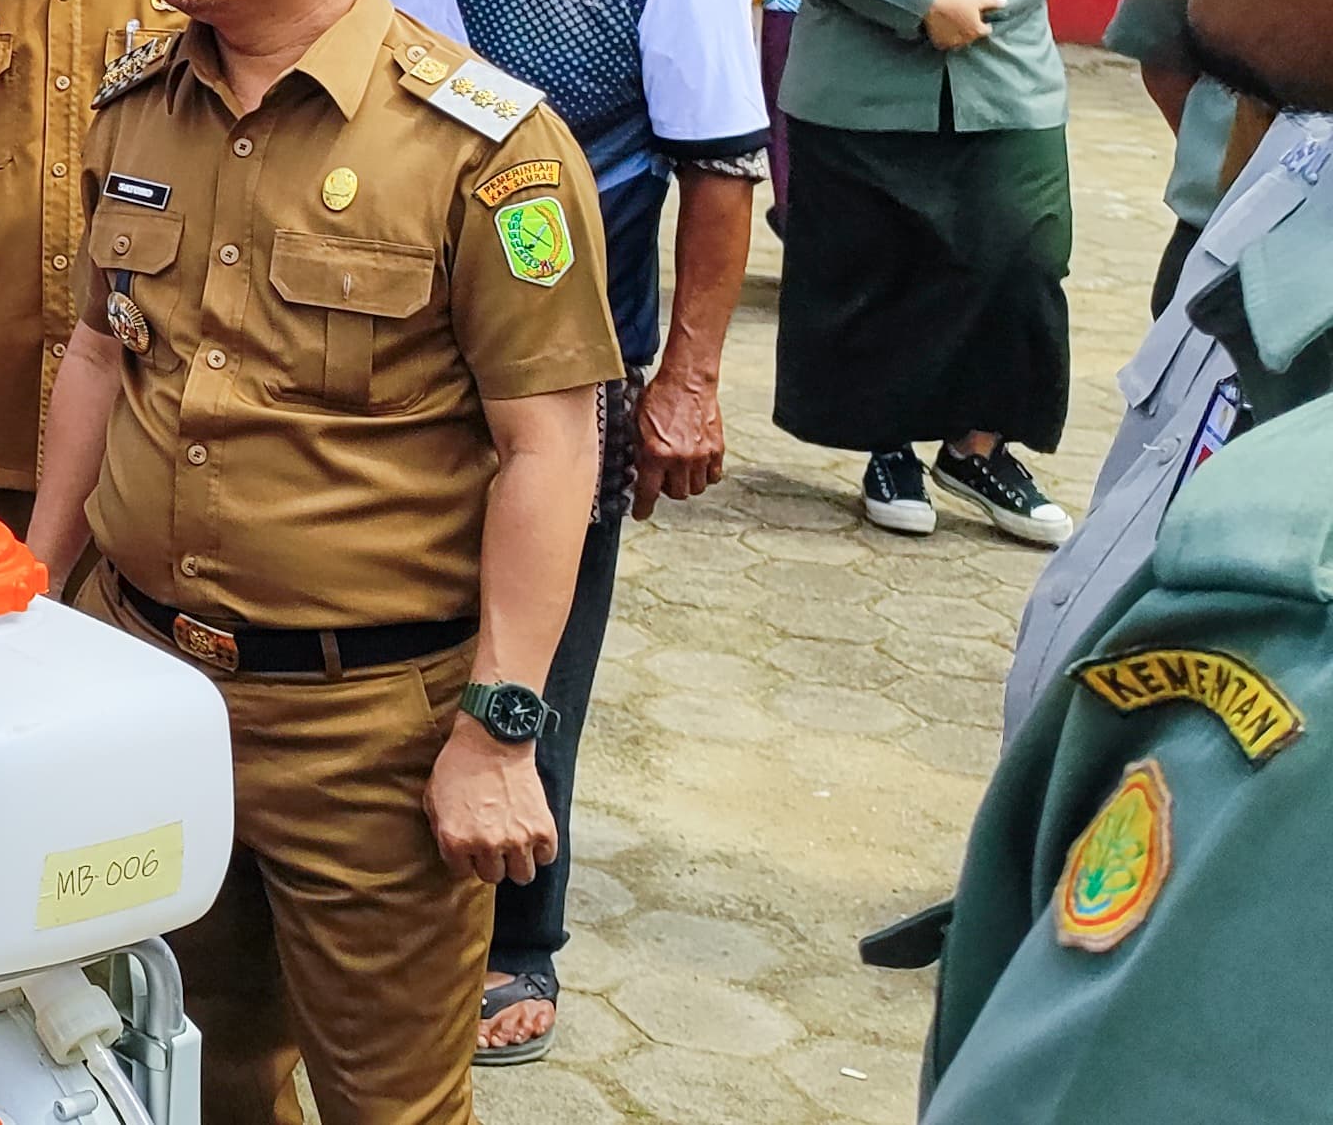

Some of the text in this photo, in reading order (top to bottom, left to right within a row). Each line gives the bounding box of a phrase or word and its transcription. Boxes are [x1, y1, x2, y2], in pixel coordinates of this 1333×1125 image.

[483, 162, 554, 196] PEMERINTAH
[1097, 656, 1278, 748] KEMENTAN
[57, 849, 159, 900] MB-006
